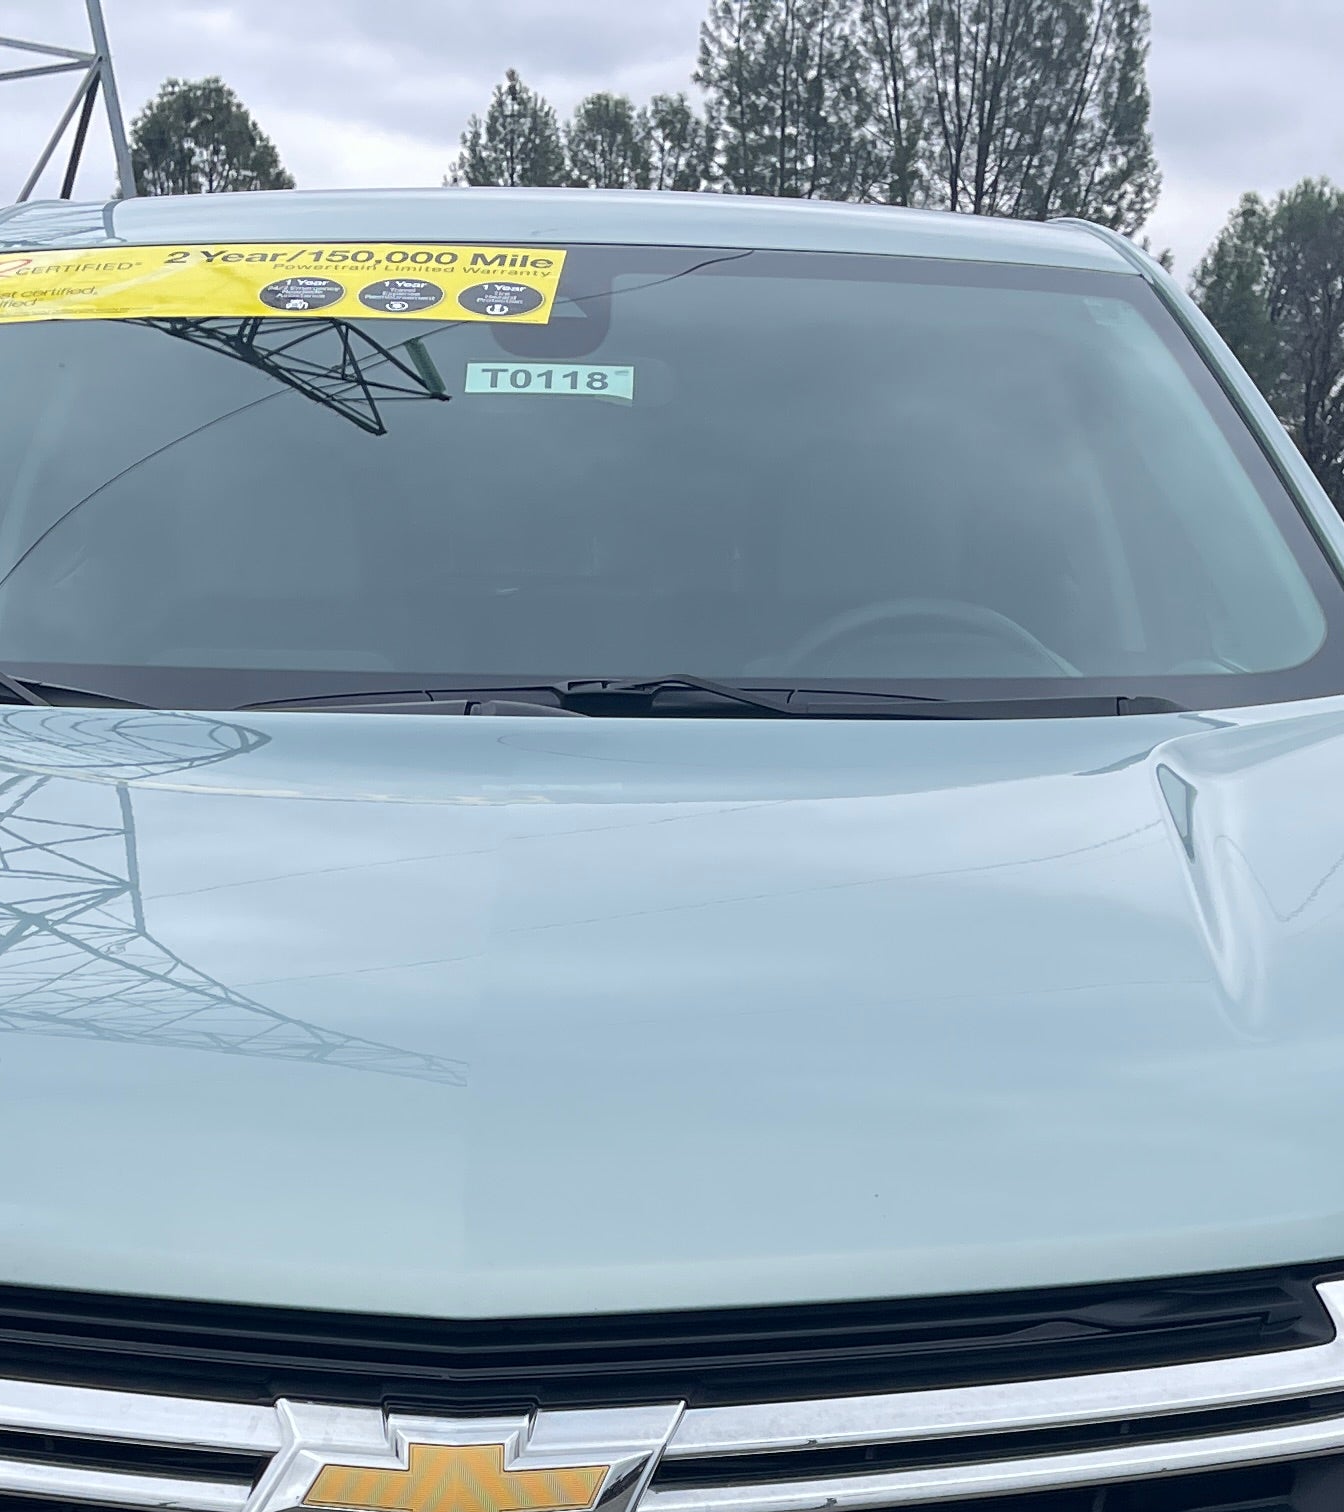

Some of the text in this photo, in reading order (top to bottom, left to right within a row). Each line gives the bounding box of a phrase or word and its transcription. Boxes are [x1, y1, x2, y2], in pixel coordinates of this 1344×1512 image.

[164, 249, 555, 269] 2 Year/150,000 Mile
[272, 263, 552, 278] Powertrain Limited Warranty
[494, 284, 527, 292] Year
[481, 368, 609, 391] T0118
